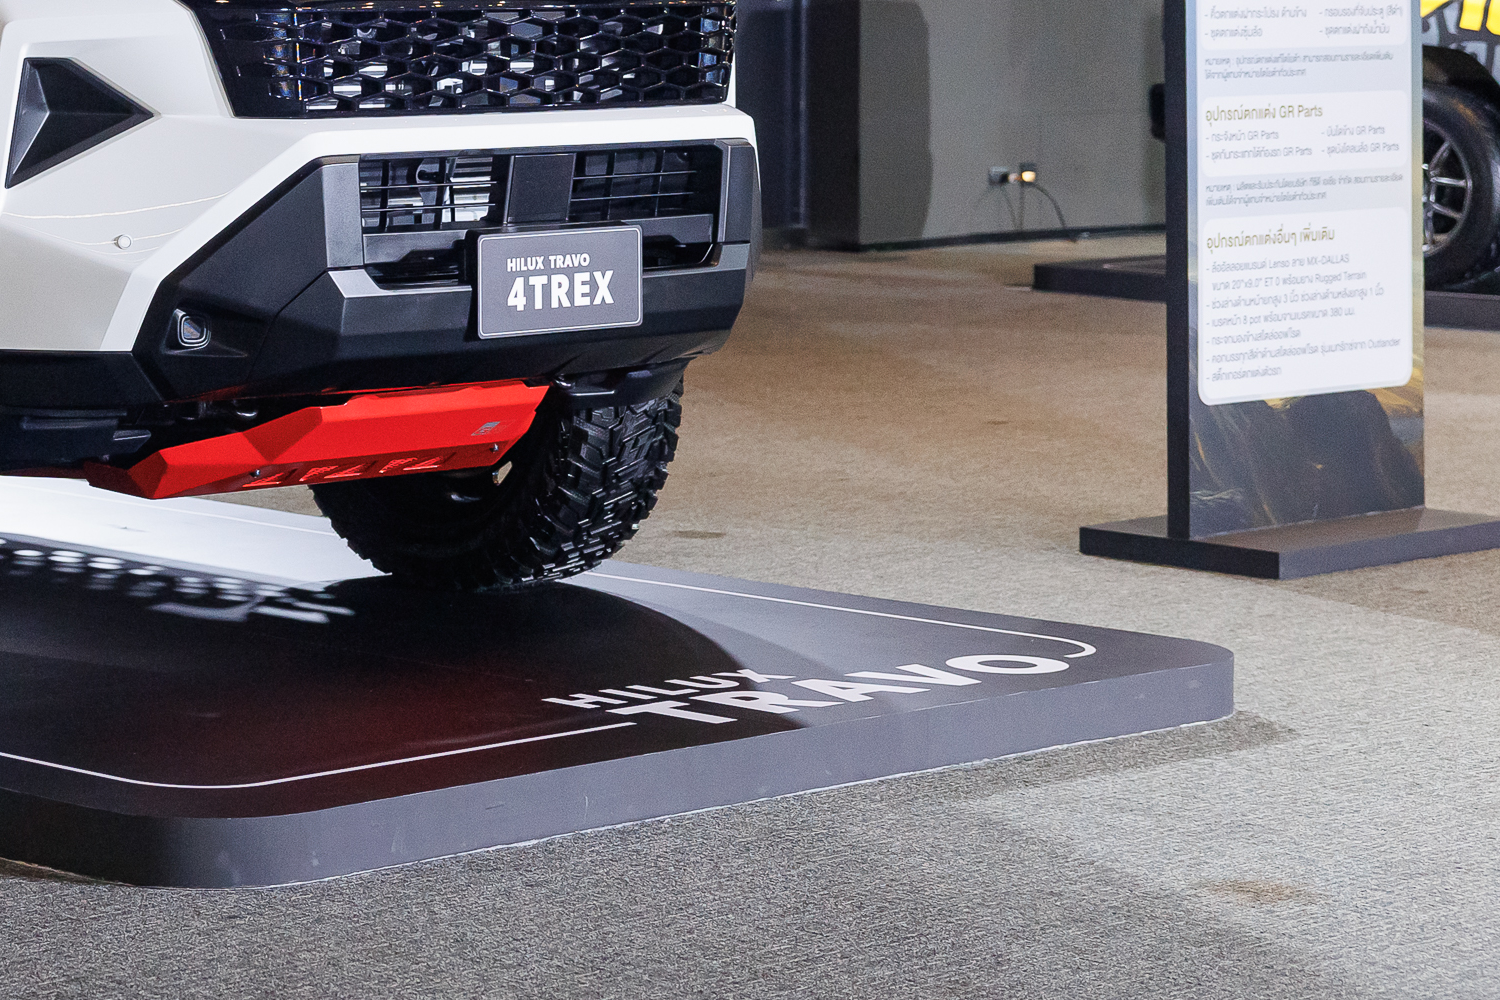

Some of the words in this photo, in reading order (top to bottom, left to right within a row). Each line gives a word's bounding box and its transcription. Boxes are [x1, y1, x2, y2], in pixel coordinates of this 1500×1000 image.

[1279, 105, 1295, 118] GR
[1297, 104, 1323, 118] Parts
[1248, 131, 1259, 141] GR
[507, 256, 545, 272] HILUX
[549, 253, 590, 269] TRAVO
[507, 269, 615, 312] 4TREX
[542, 668, 797, 709] HILUX
[605, 654, 1070, 725] TRAVO
